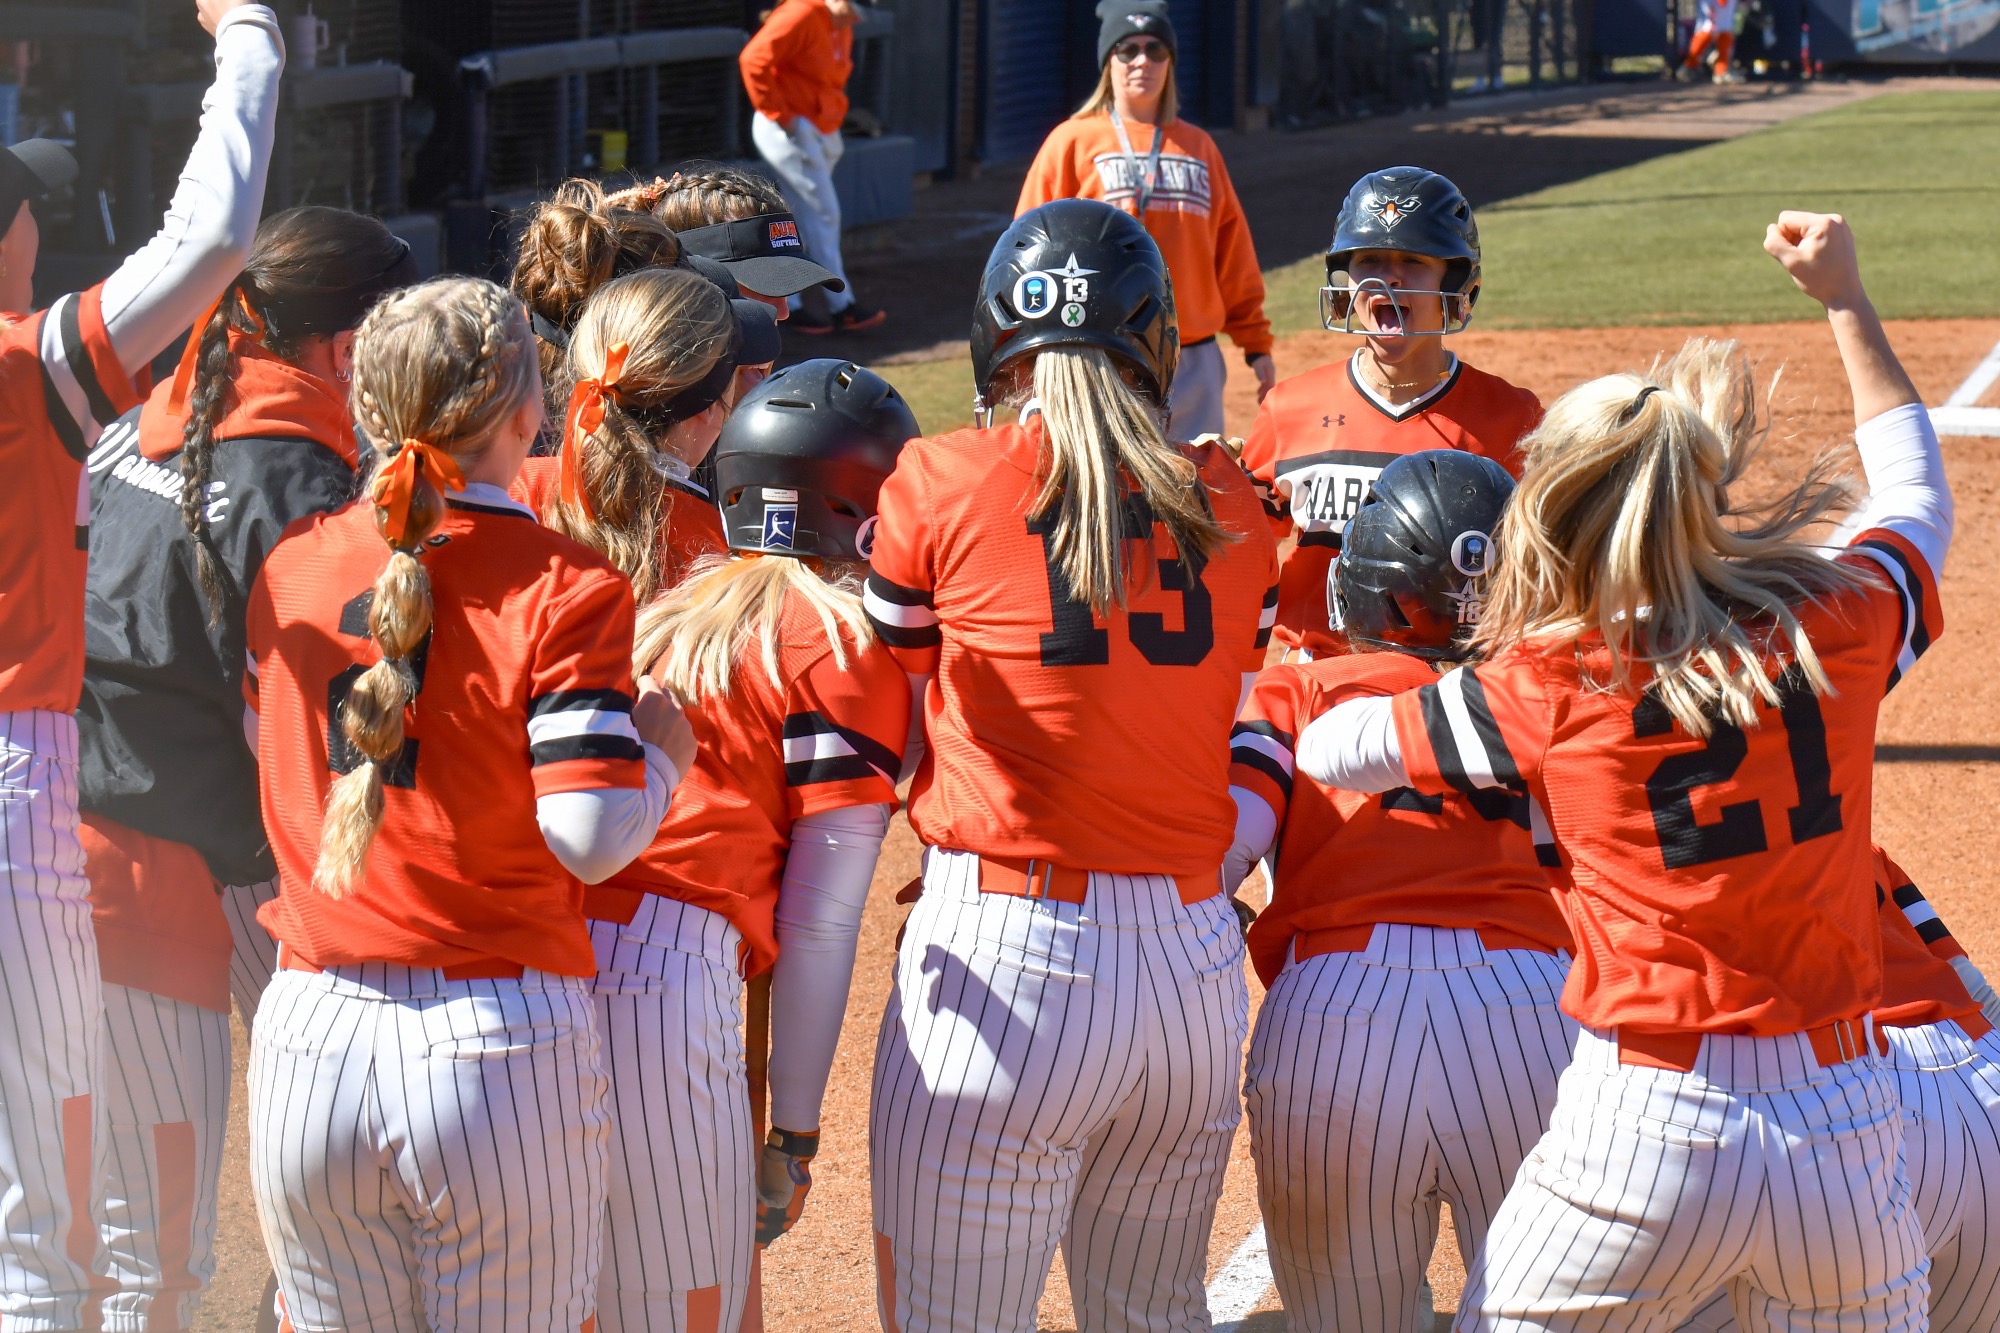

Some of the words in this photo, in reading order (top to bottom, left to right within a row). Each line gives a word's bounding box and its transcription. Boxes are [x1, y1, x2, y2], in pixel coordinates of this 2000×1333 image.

[1096, 159, 1210, 199] WARAWKS
[769, 221, 798, 241] AUM
[1062, 278, 1089, 302] 13
[1303, 477, 1375, 520] WAR
[1025, 491, 1214, 667] 13
[1456, 602, 1482, 624] 18
[1632, 661, 1843, 870] 21
